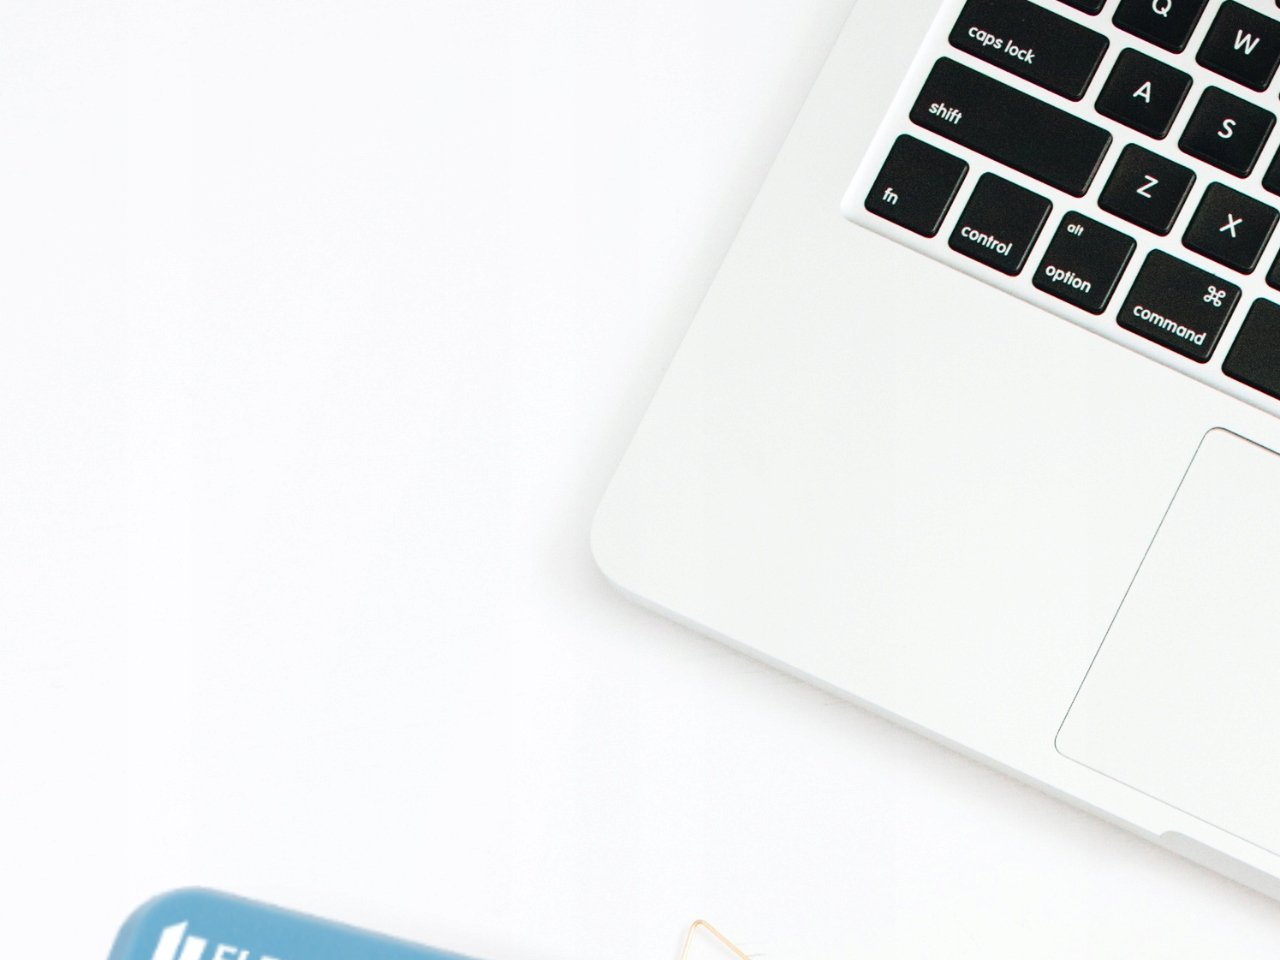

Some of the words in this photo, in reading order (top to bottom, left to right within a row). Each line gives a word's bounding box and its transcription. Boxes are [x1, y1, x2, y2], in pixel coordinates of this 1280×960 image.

[1151, 0, 1172, 18] Q
[968, 26, 1004, 49] caps
[1004, 39, 1036, 65] lock
[1233, 29, 1260, 55] W
[1132, 81, 1152, 104] A
[928, 100, 963, 126] shift
[1217, 118, 1237, 139] S
[882, 187, 899, 206] fn
[1136, 174, 1159, 199] Z
[1066, 222, 1084, 237] alt
[1219, 213, 1243, 238] X
[960, 223, 1013, 257] control
[1045, 263, 1092, 294] option
[1132, 302, 1206, 347] command
